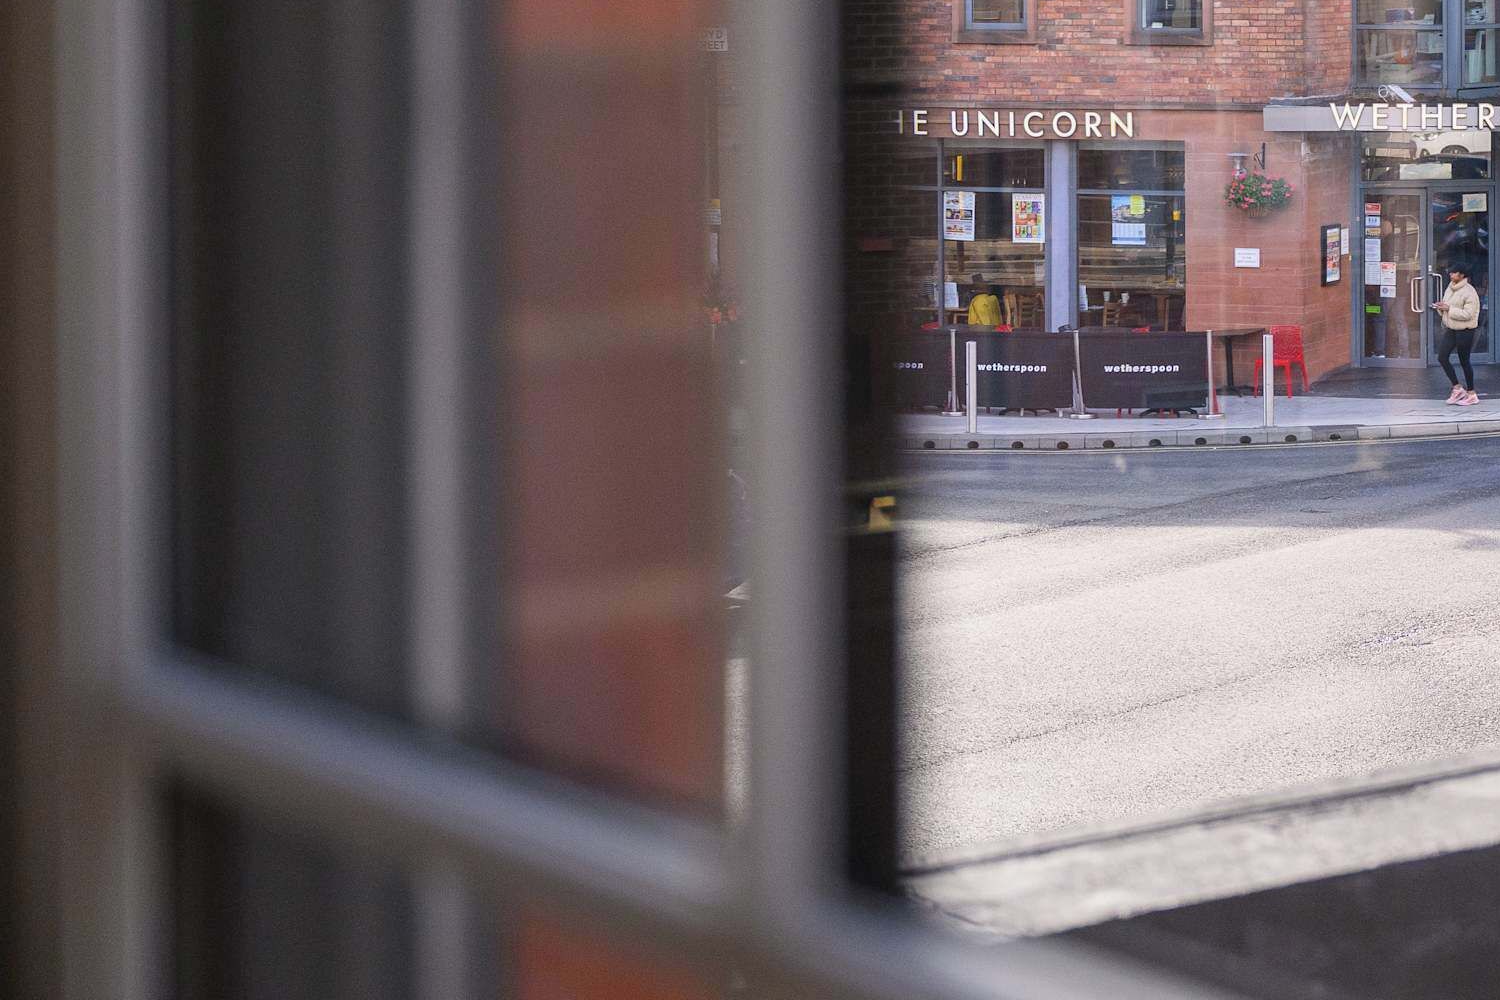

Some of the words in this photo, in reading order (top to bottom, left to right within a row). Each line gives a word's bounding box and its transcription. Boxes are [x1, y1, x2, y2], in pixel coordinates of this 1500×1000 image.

[951, 110, 1133, 138] UNICORN
[977, 363, 1047, 373] wetherspoon
[1103, 364, 1179, 374] wetherspoon
